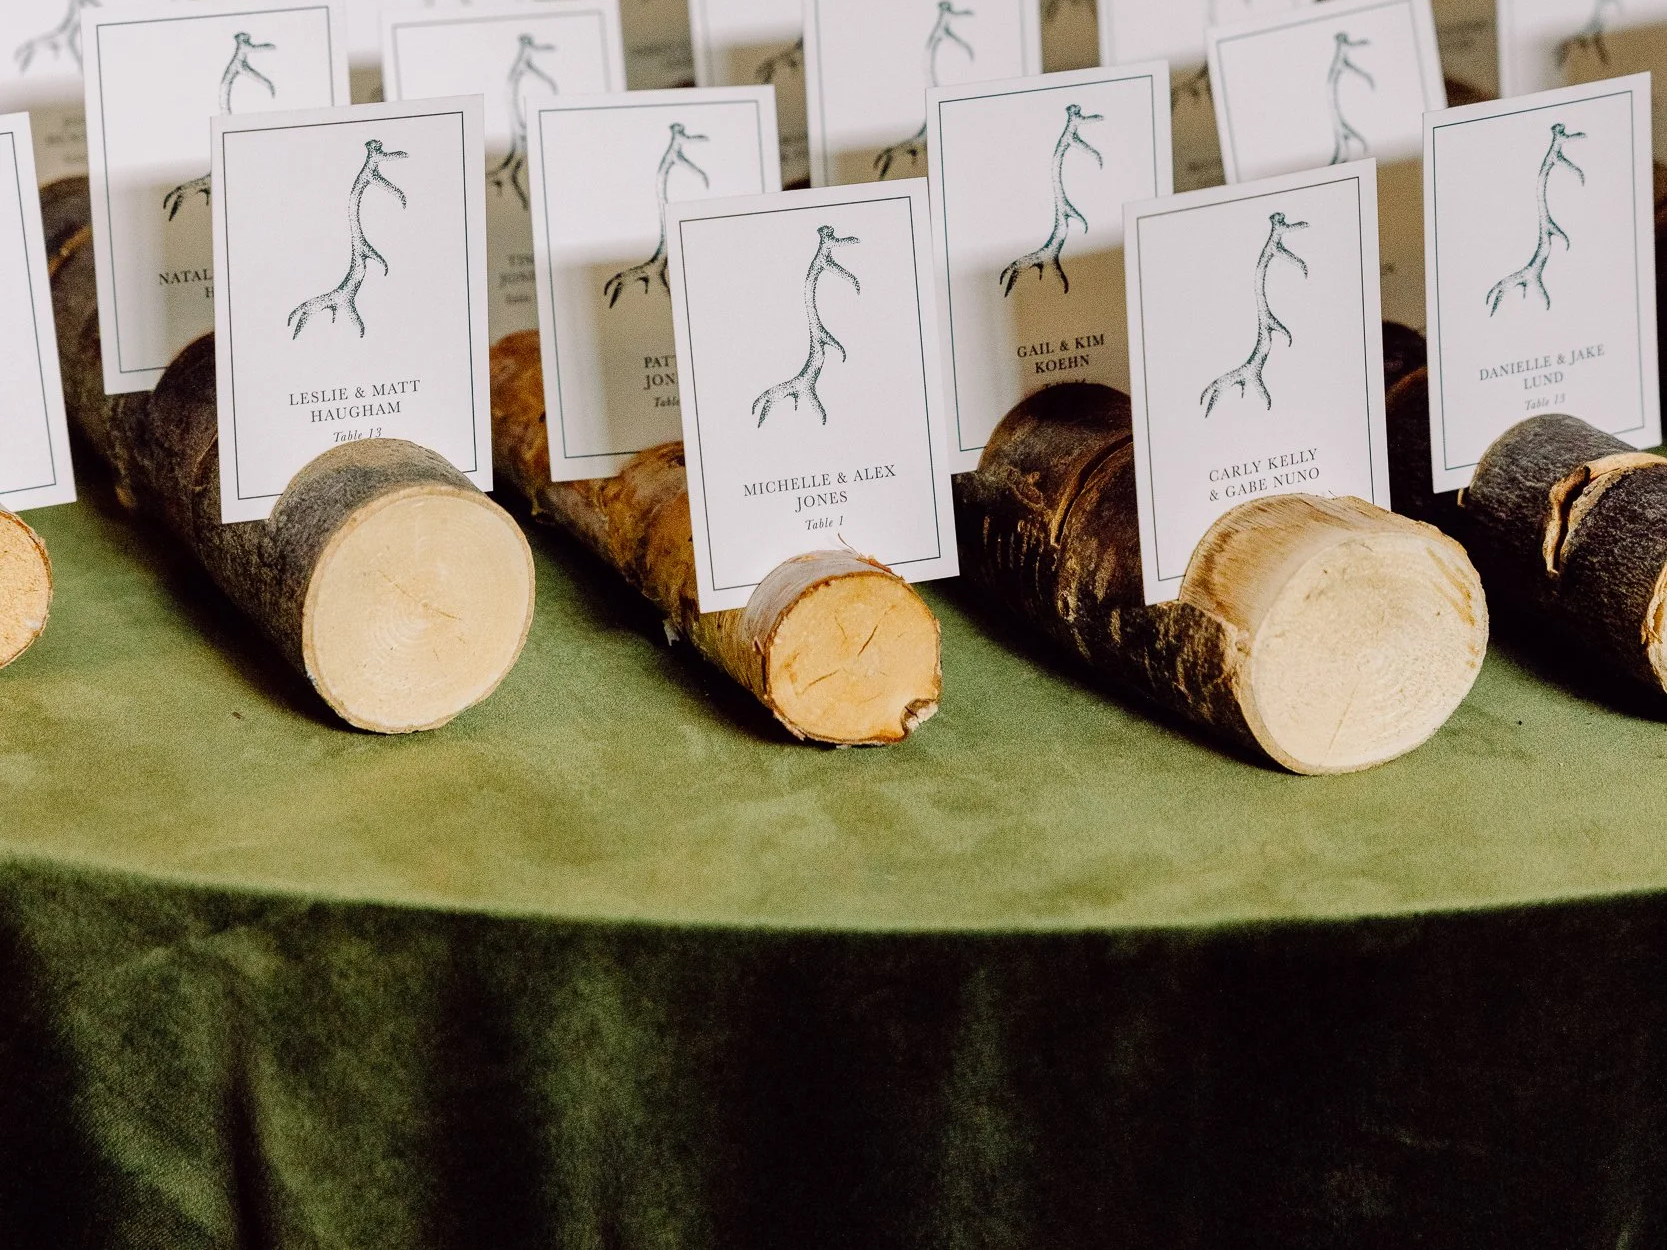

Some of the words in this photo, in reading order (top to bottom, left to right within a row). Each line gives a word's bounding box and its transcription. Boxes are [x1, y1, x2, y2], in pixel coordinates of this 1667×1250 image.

[1017, 342, 1054, 358] GAIL
[1059, 340, 1070, 352] &
[1075, 333, 1104, 350] KIM
[1035, 354, 1090, 374] KOEHN
[1479, 355, 1552, 381] DANIELLE
[1556, 353, 1566, 365] &
[1568, 343, 1605, 366] JAKE
[1524, 371, 1564, 390] LUND
[289, 387, 348, 406] LESLIE
[354, 386, 366, 399] &
[372, 379, 421, 397] MATT
[1525, 396, 1549, 411] Table
[311, 400, 402, 423] HAUGHAM
[333, 429, 363, 443] Table
[368, 427, 382, 439] 13
[1209, 460, 1261, 482] CARLY
[1268, 448, 1317, 470] KELLY
[743, 473, 831, 497] MICHELLE
[837, 471, 848, 484] &
[853, 464, 897, 482] ALEX
[1209, 489, 1220, 502] &
[1225, 478, 1267, 498] GABE
[1273, 467, 1320, 488] NUNO
[794, 490, 848, 513] JONES
[805, 517, 834, 530] Table
